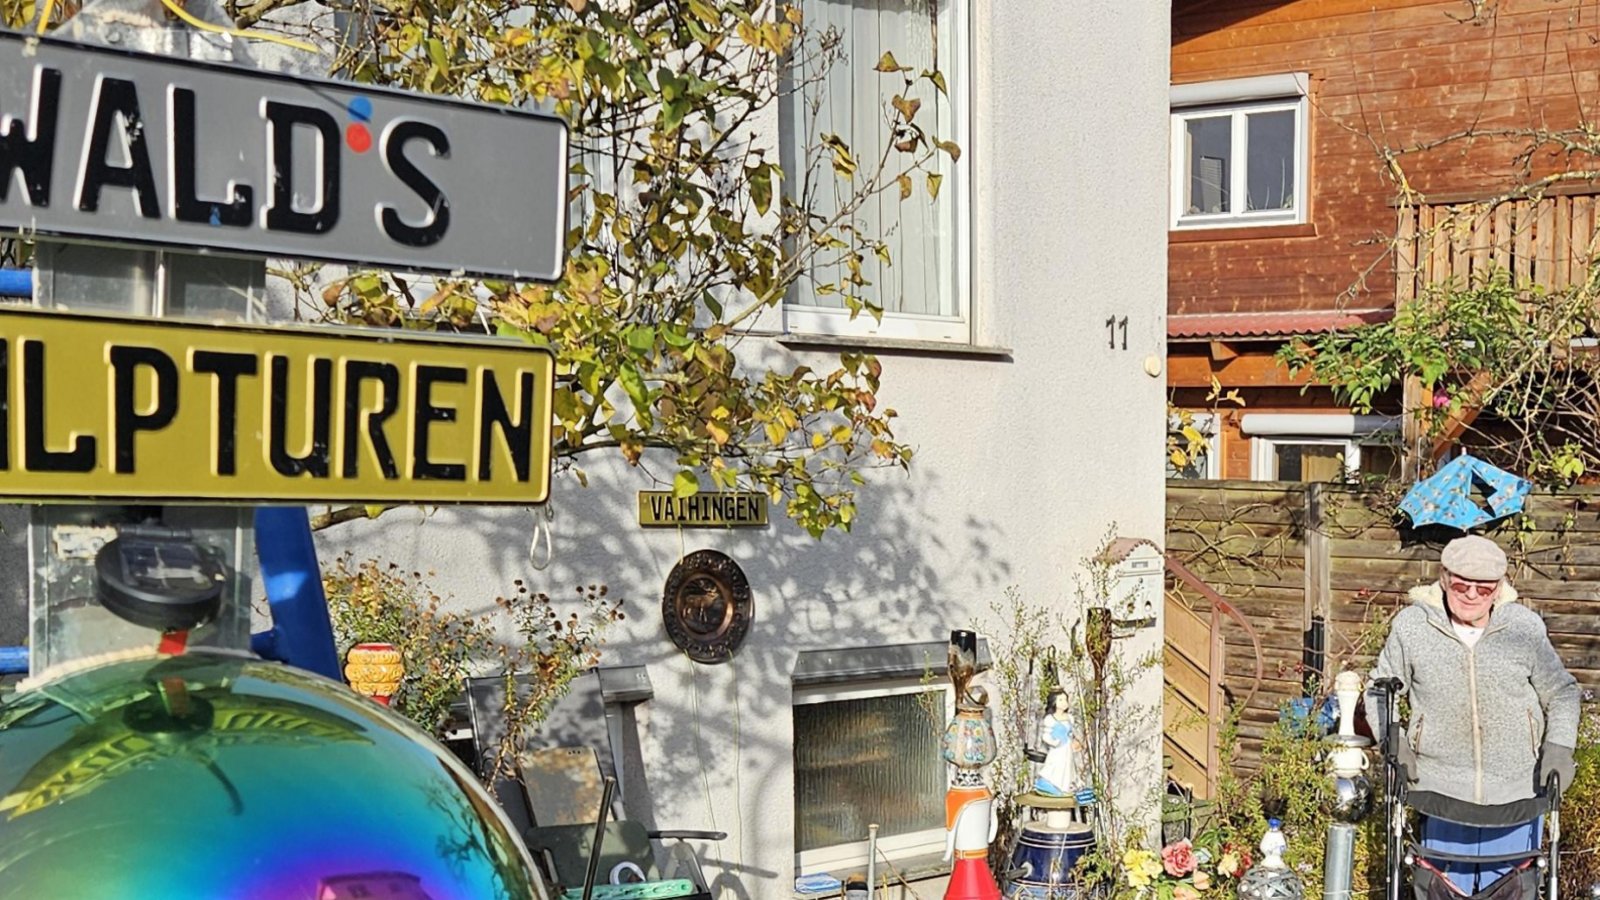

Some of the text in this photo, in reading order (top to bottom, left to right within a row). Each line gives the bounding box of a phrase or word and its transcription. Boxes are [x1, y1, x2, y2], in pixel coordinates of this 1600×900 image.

[1105, 314, 1128, 350] 11
[0, 337, 535, 482] LPTUREN
[650, 495, 760, 521] VAIHINGEN
